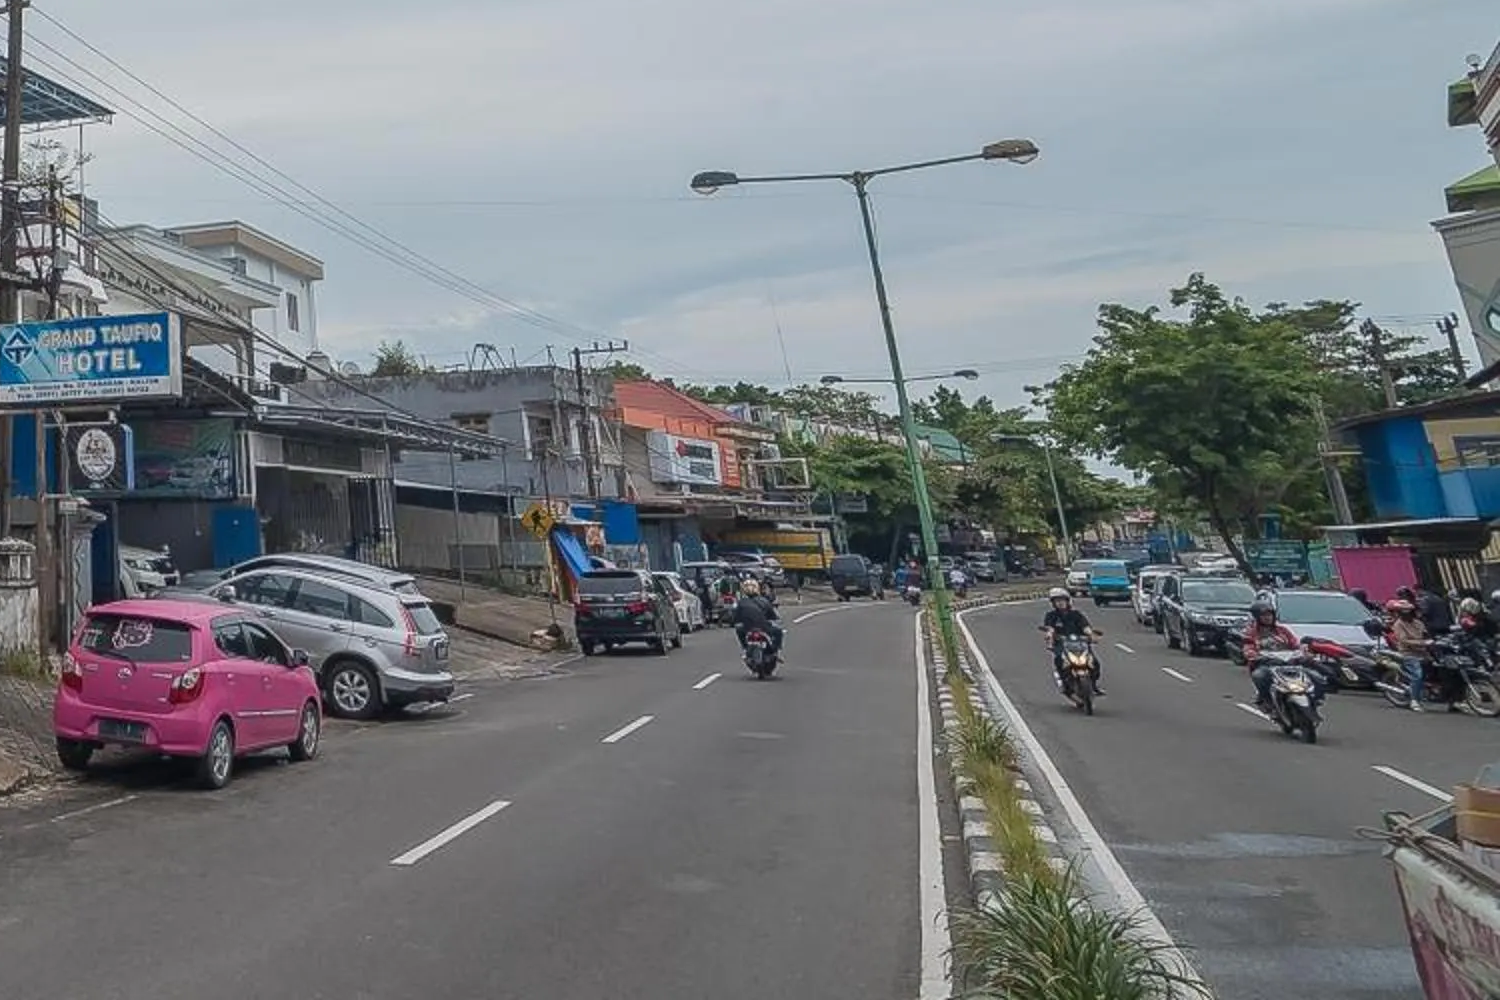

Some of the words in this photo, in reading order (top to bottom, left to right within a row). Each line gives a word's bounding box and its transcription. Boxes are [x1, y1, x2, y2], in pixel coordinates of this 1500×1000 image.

[38, 328, 96, 349] GRAND
[101, 322, 163, 344] TAUFIQ
[57, 349, 142, 374] HOTEL
